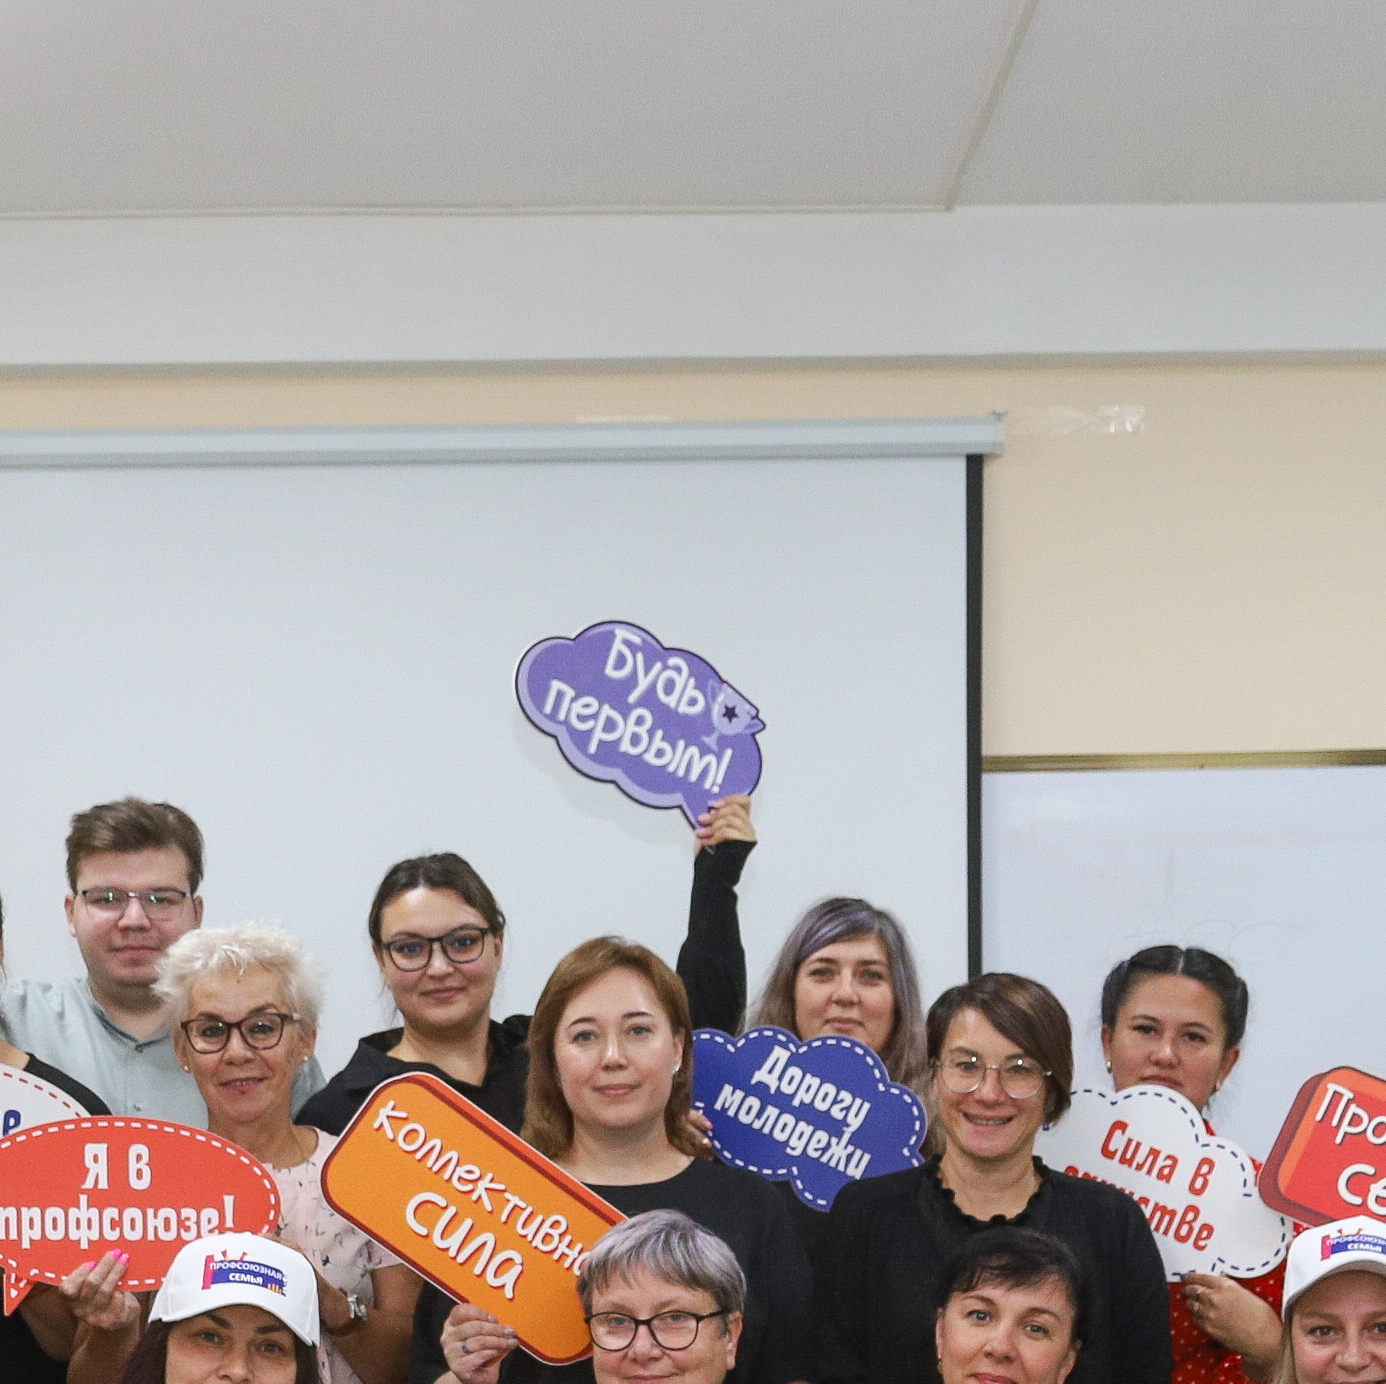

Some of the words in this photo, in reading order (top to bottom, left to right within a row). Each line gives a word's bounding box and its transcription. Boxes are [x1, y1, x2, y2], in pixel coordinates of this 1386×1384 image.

[604, 628, 706, 715] Будь
[543, 679, 733, 794] первым!
[713, 1082, 872, 1180] молодежи
[750, 1044, 871, 1133] Дорогу
[81, 1142, 109, 1190] Я
[127, 1143, 153, 1190] в
[1101, 1120, 1179, 1184] Сила
[210, 1262, 282, 1280] ПРОФСОЮЗНАЯ
[229, 1273, 263, 1285] СЕМЬЯ
[405, 1191, 523, 1300] сила
